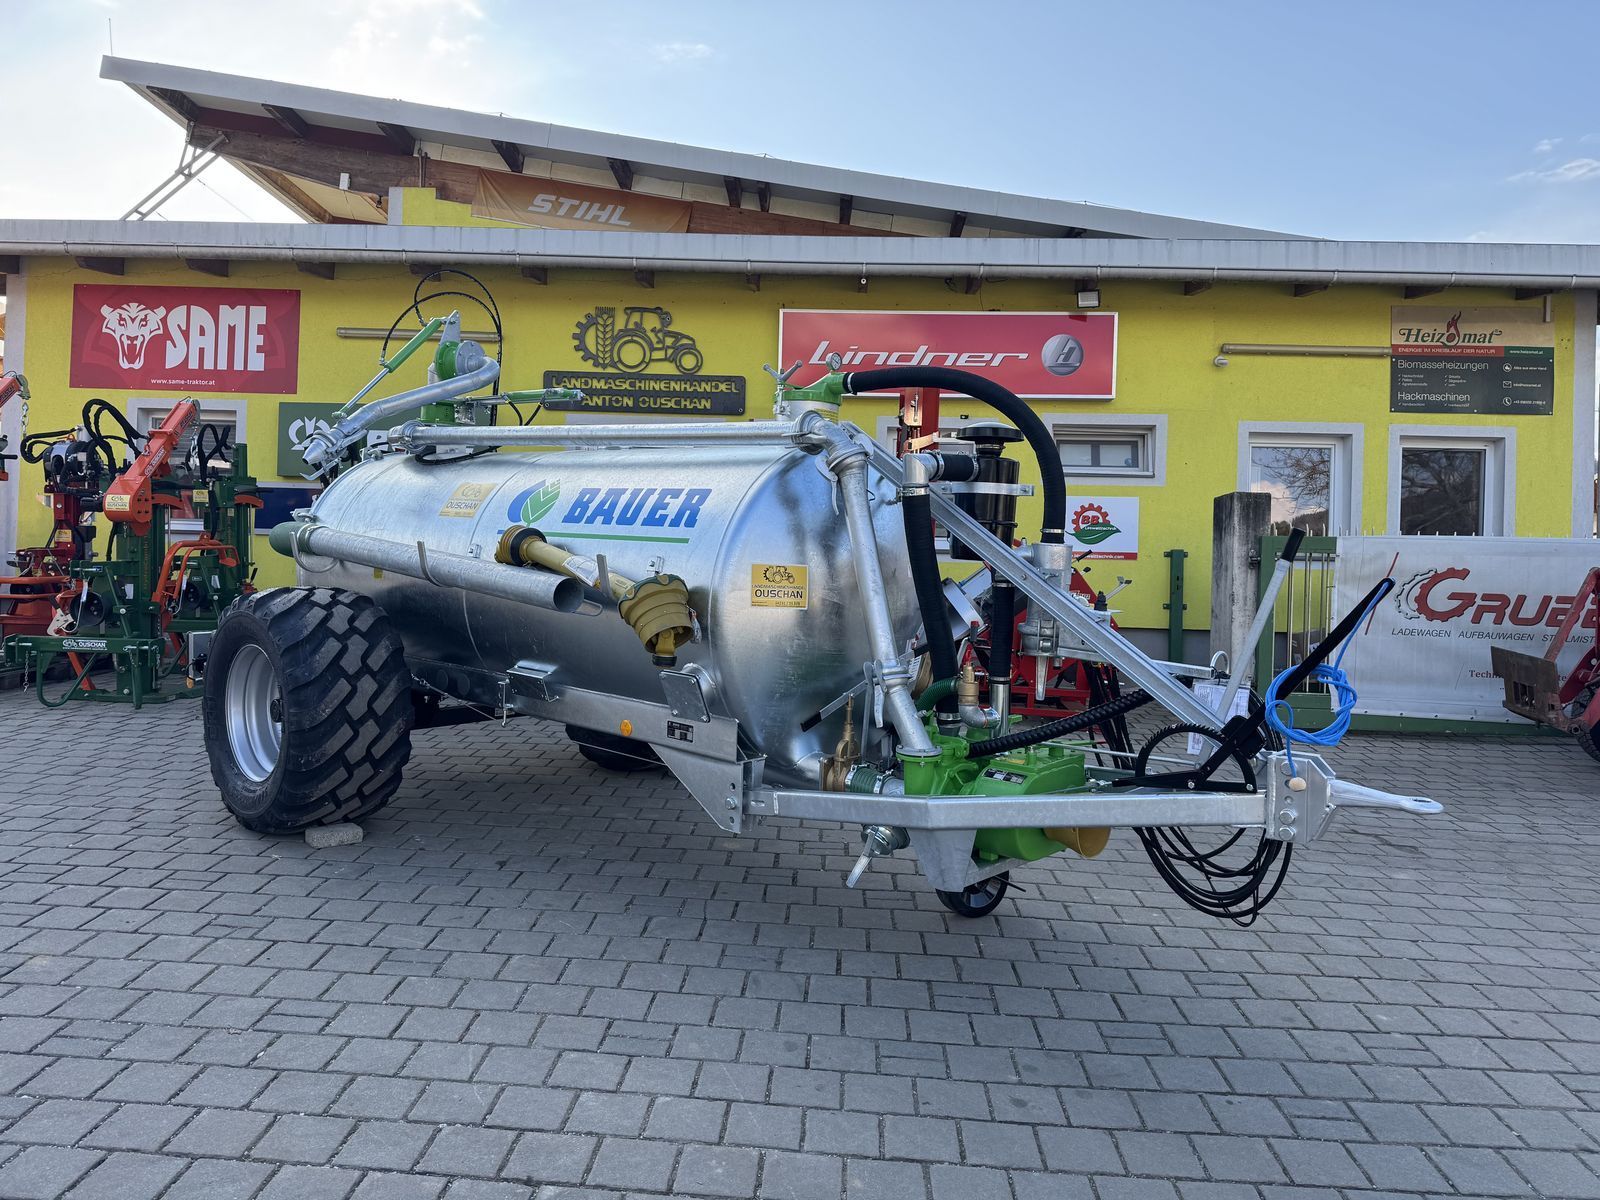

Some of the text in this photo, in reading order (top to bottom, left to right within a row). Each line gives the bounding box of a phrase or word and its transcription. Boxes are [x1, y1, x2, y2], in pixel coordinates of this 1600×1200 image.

[527, 193, 631, 227] STIHL
[165, 304, 267, 371] SAME
[808, 340, 1028, 367] Lindner
[1397, 360, 1489, 371] Biomasseheizungen
[150, 376, 216, 386] www.same-traktor.at
[552, 376, 740, 393] LANDMASCHINENHANDEL
[581, 395, 712, 409] ANTON OUSCHAN
[1397, 392, 1471, 402] Hackmaschinen
[561, 487, 712, 528] BAUER
[754, 588, 803, 599] OUSCHAN
[1391, 627, 1452, 638] LADEWAGEN
[1458, 630, 1535, 642] AUFBAUWAGEN
